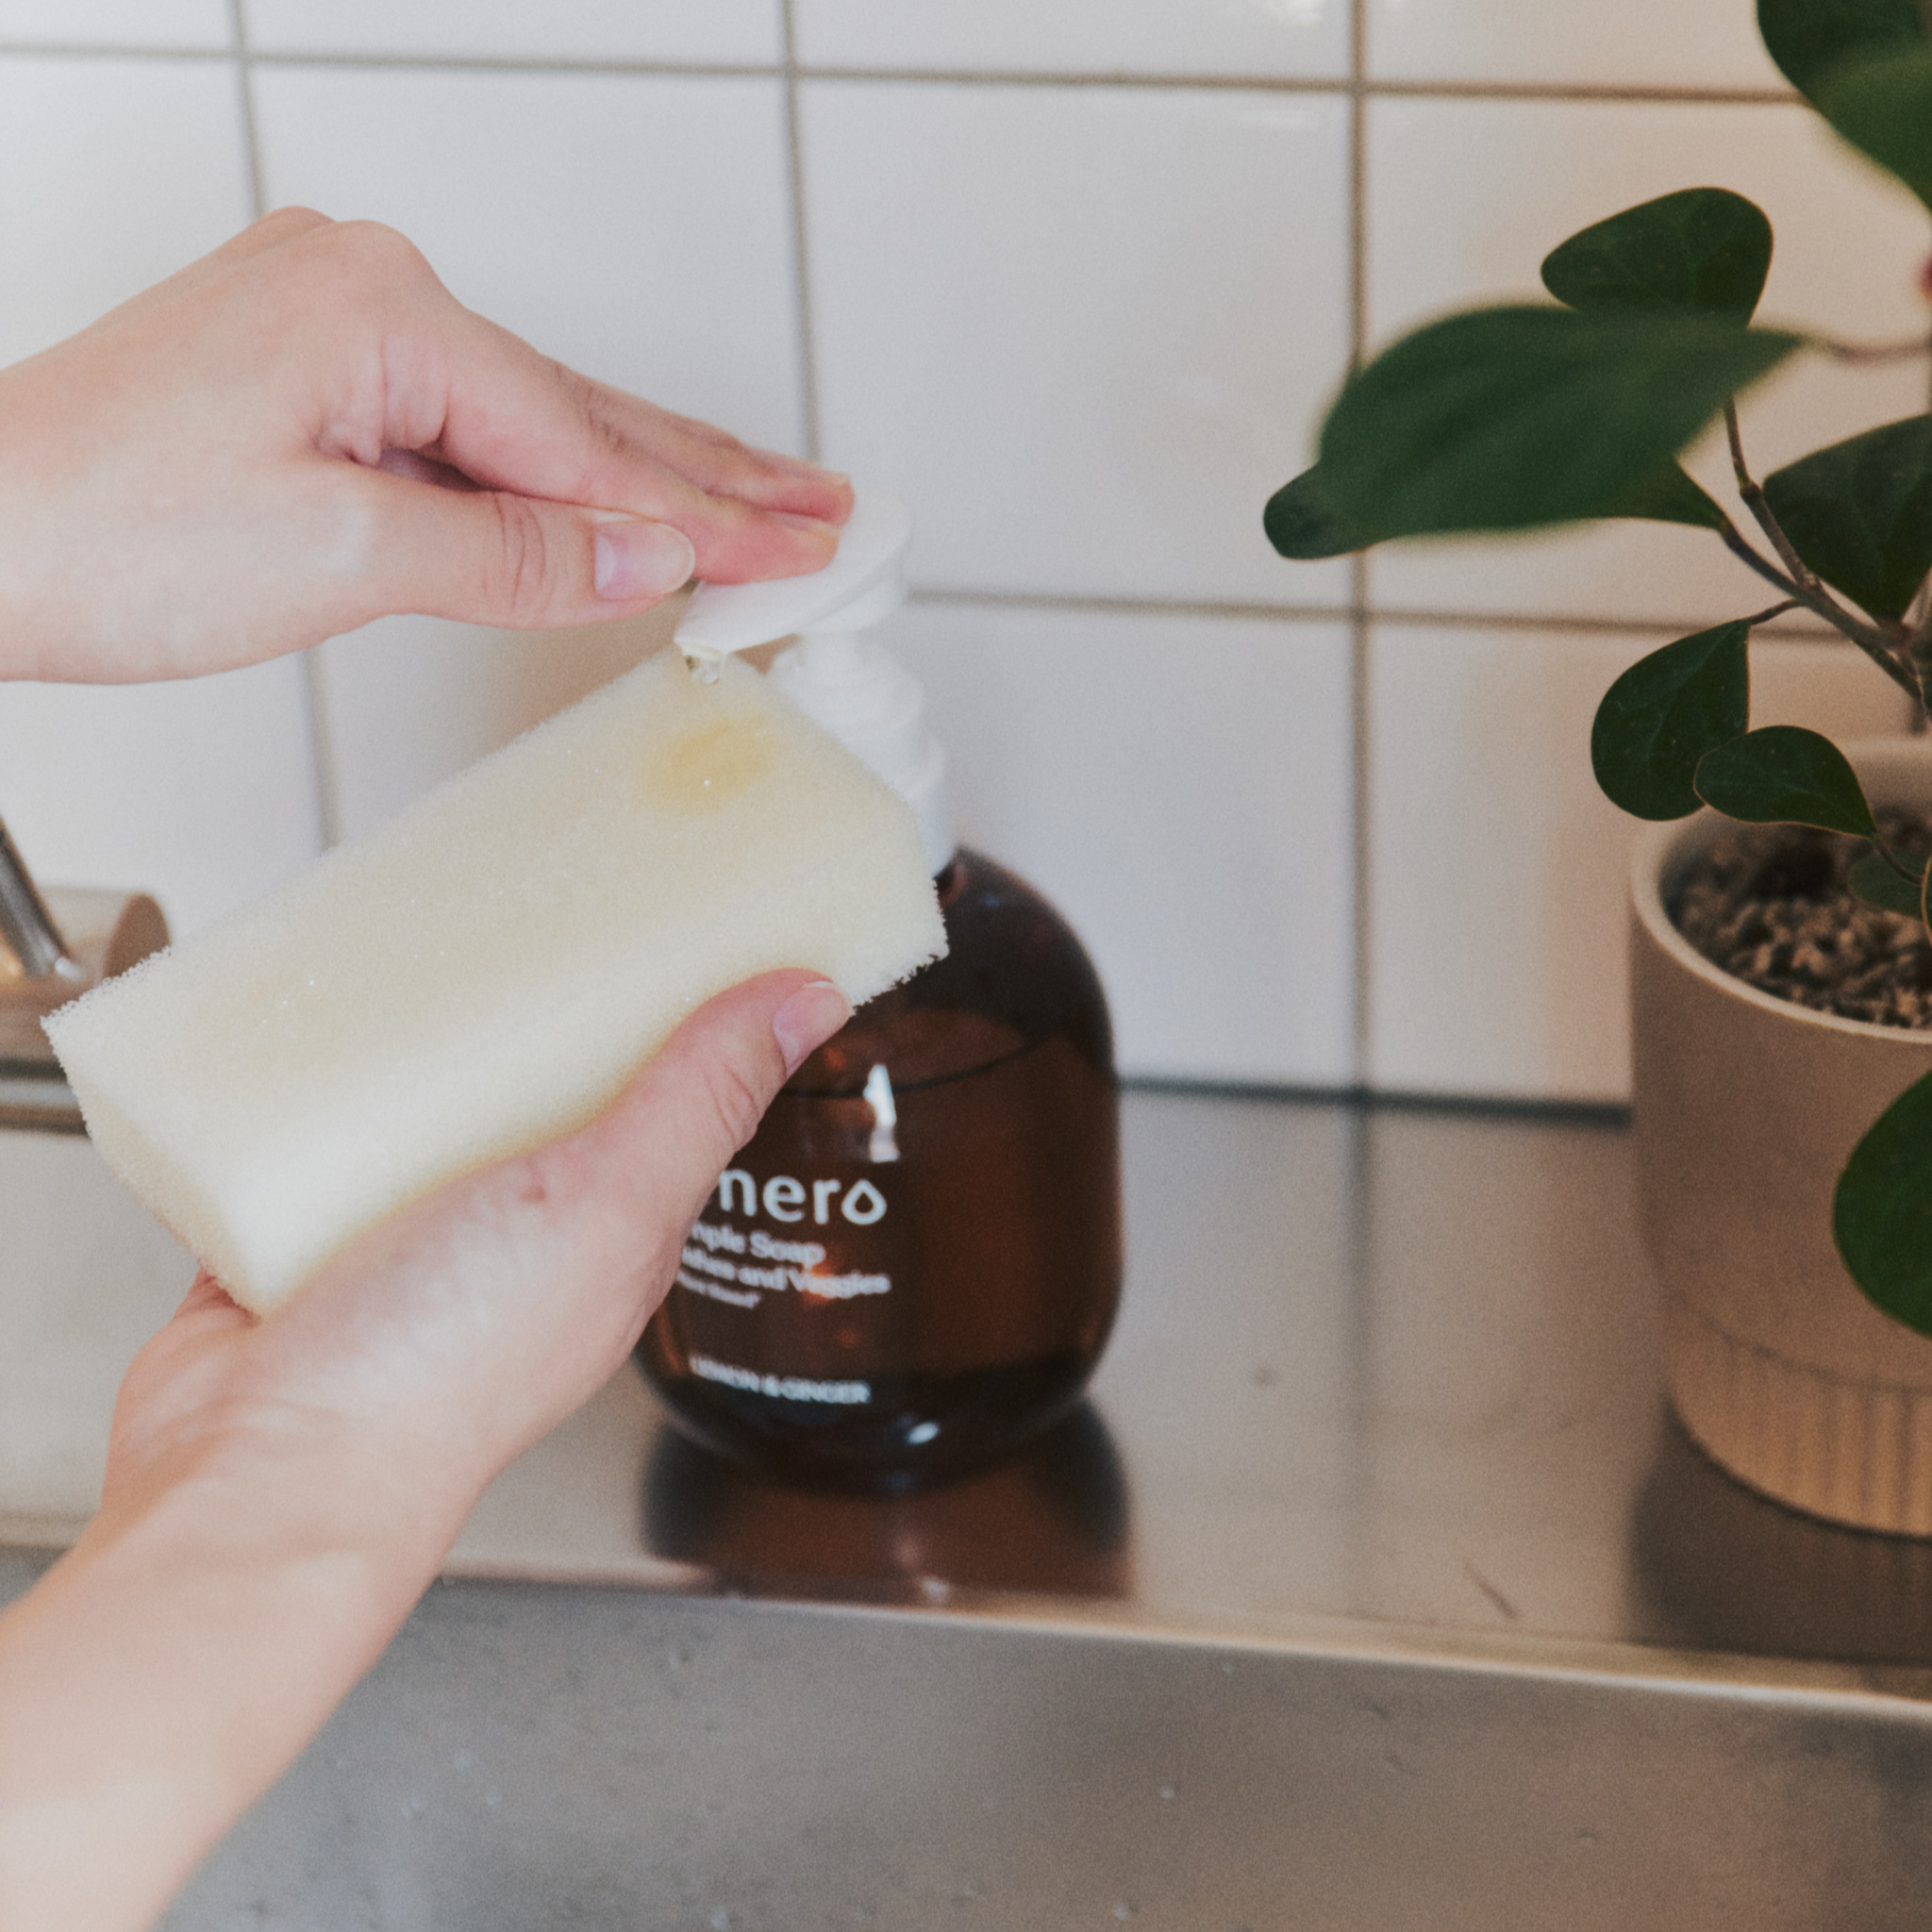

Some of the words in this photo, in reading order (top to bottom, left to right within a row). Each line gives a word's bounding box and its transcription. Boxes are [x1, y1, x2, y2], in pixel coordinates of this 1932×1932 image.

[718, 1169, 888, 1224] nero
[750, 1230, 825, 1269] Soap
[739, 1267, 788, 1291] and
